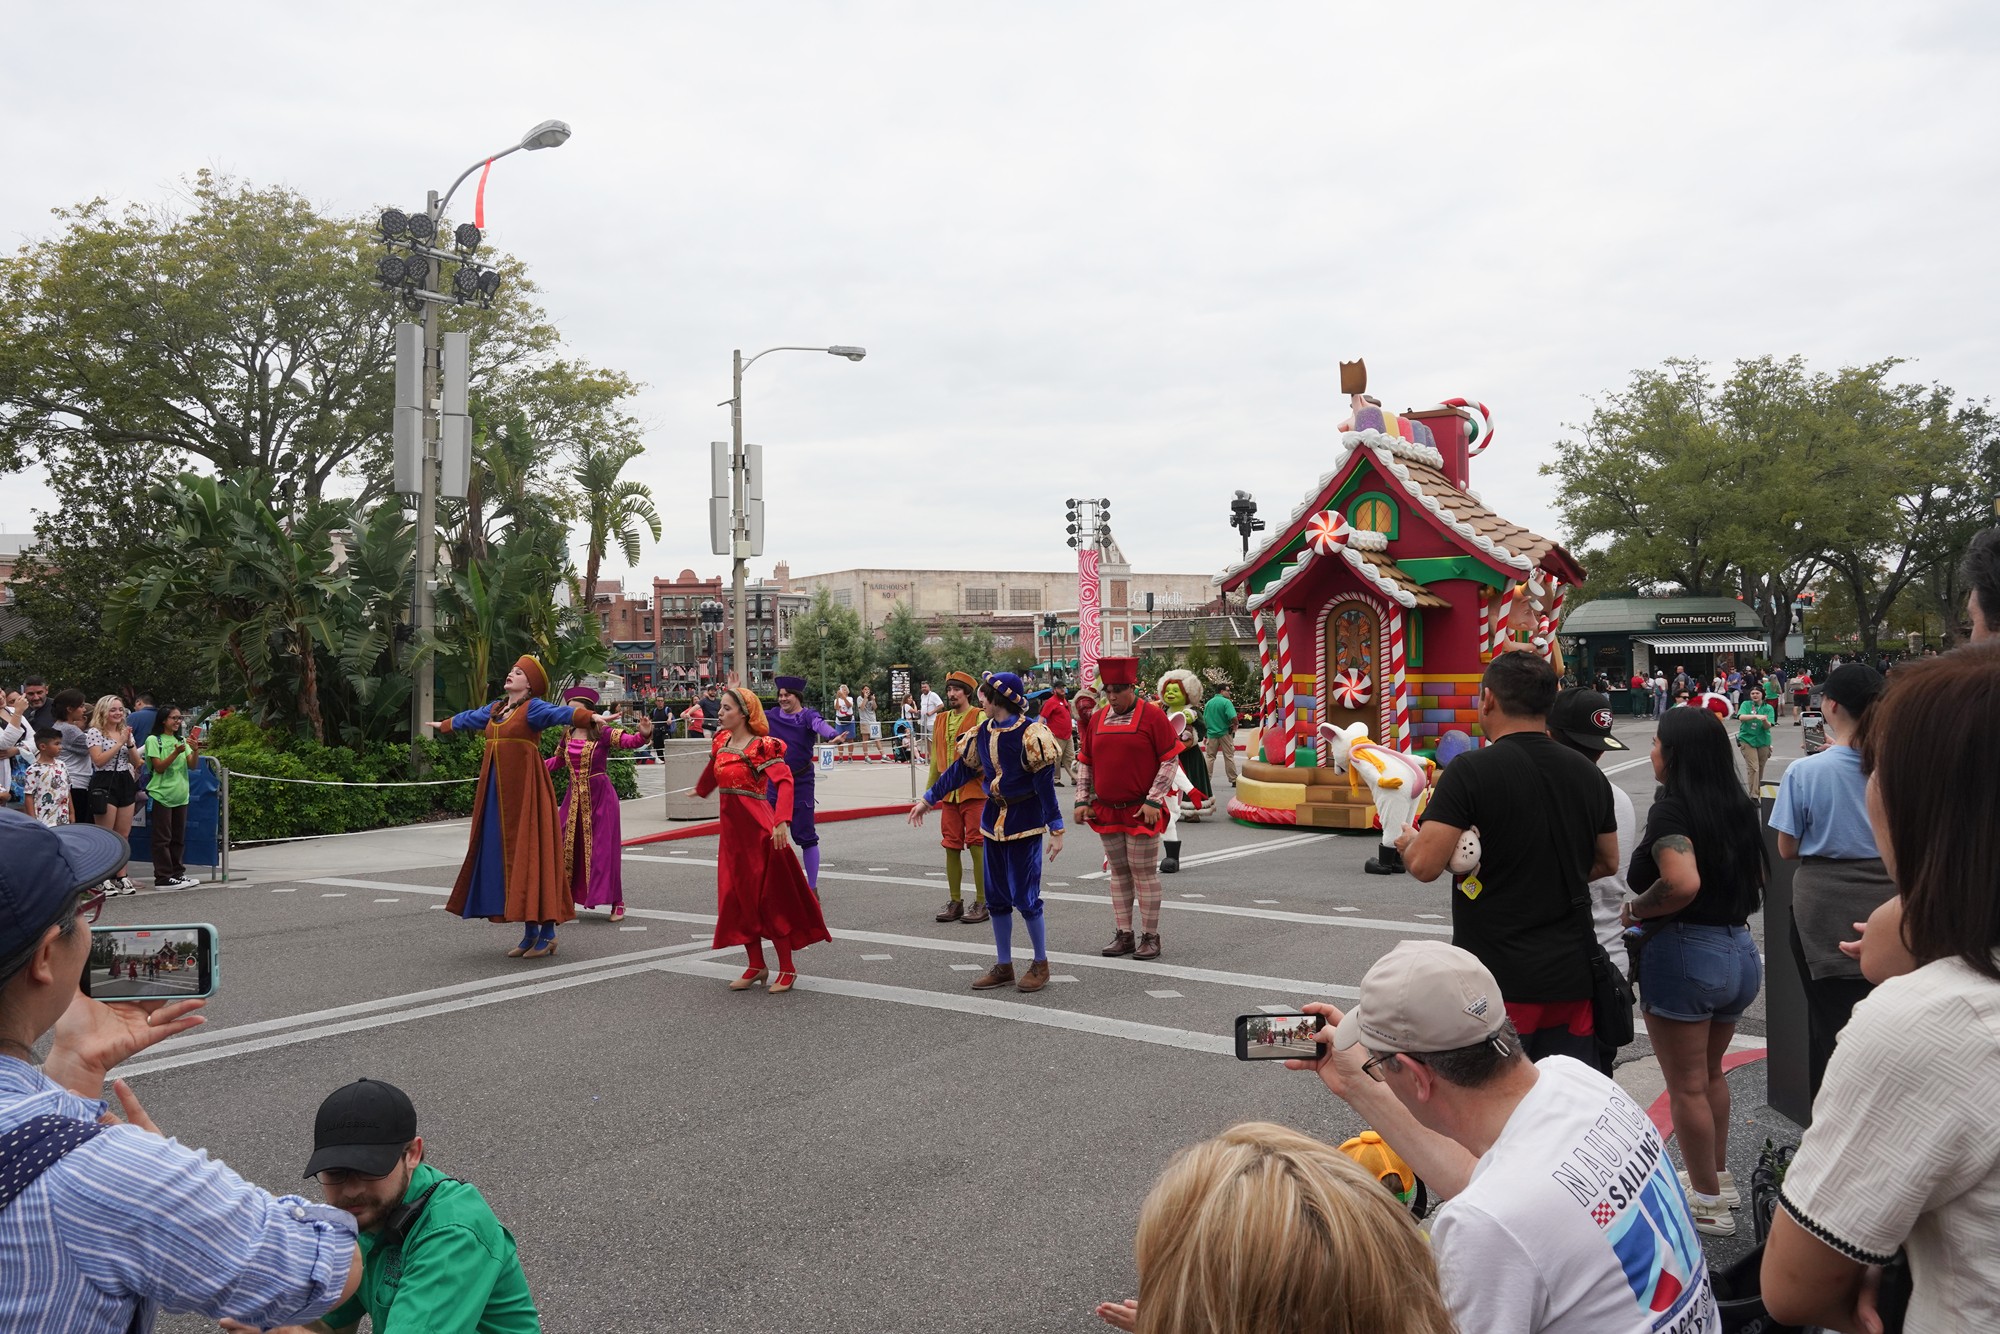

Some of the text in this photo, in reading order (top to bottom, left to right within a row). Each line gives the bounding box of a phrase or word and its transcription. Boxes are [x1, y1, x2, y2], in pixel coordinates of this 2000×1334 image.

[1133, 590, 1182, 604] Ghardelli
[1660, 616, 1688, 624] CENTRAL
[1689, 616, 1706, 624] PARK
[1609, 1131, 1660, 1210] SAILING
